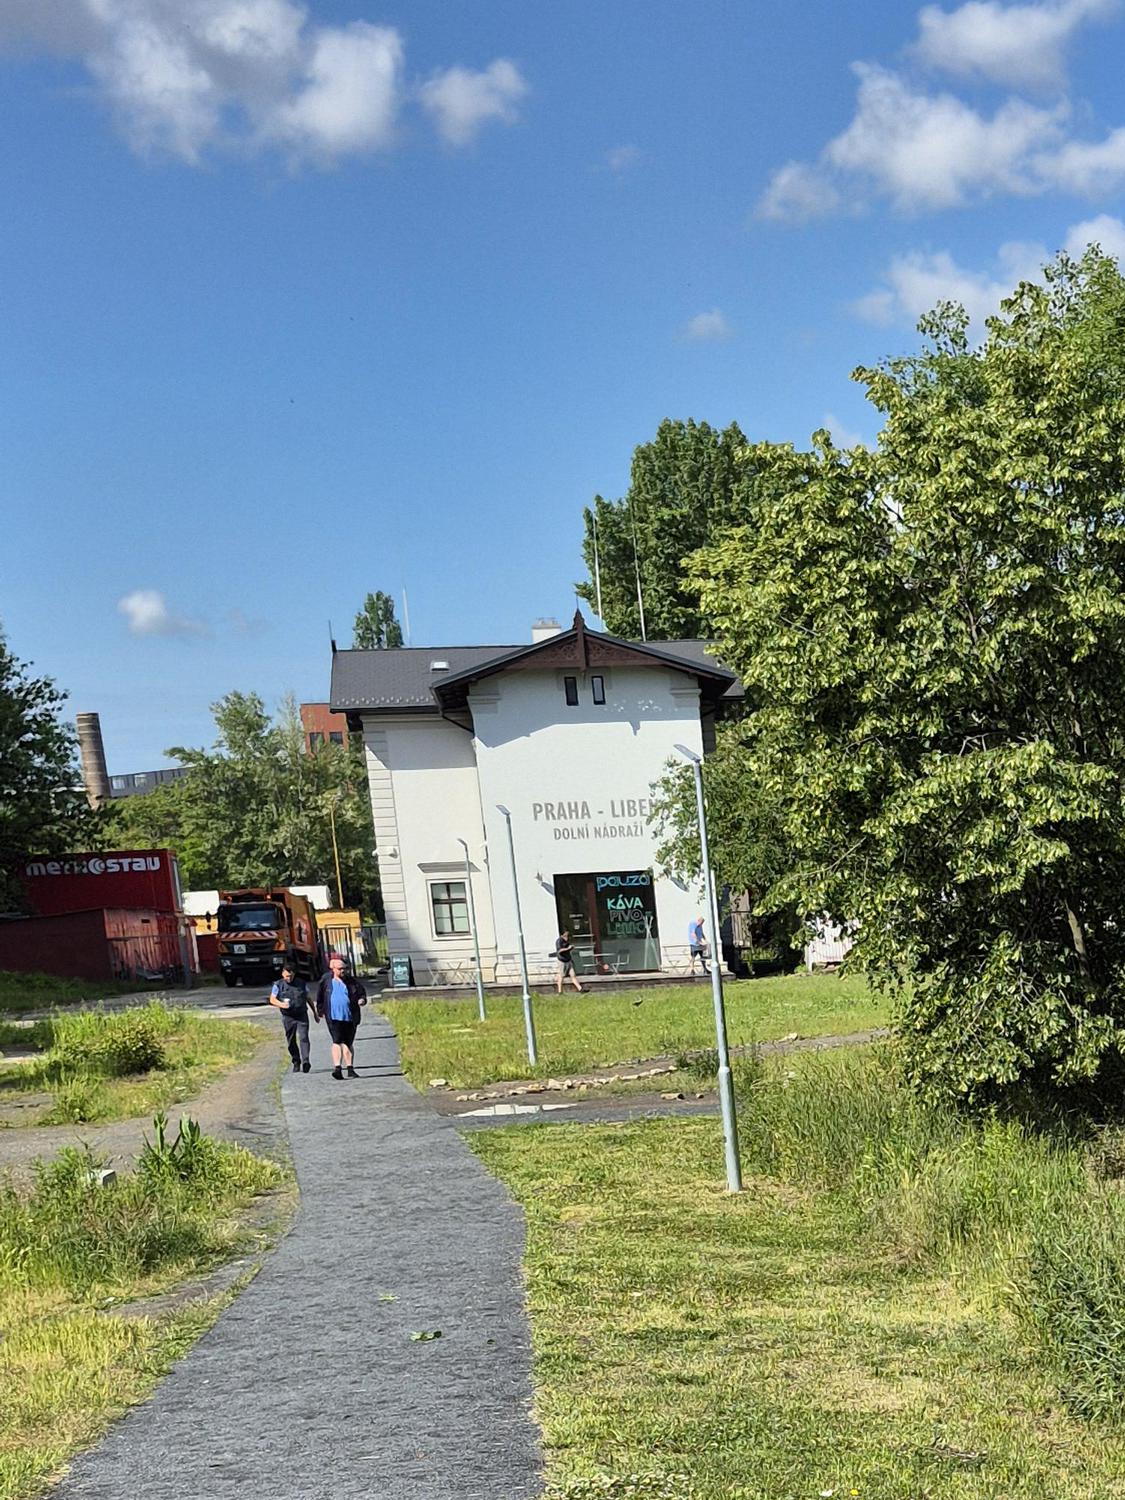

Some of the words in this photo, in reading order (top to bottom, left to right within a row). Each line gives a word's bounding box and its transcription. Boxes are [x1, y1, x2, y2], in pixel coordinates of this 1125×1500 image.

[532, 801, 592, 822] PRAHA
[553, 823, 590, 841] DOLNÍ
[594, 821, 644, 839] NÁDRAŽÍ
[596, 874, 651, 892] pauza
[607, 894, 644, 910] KÁVA
